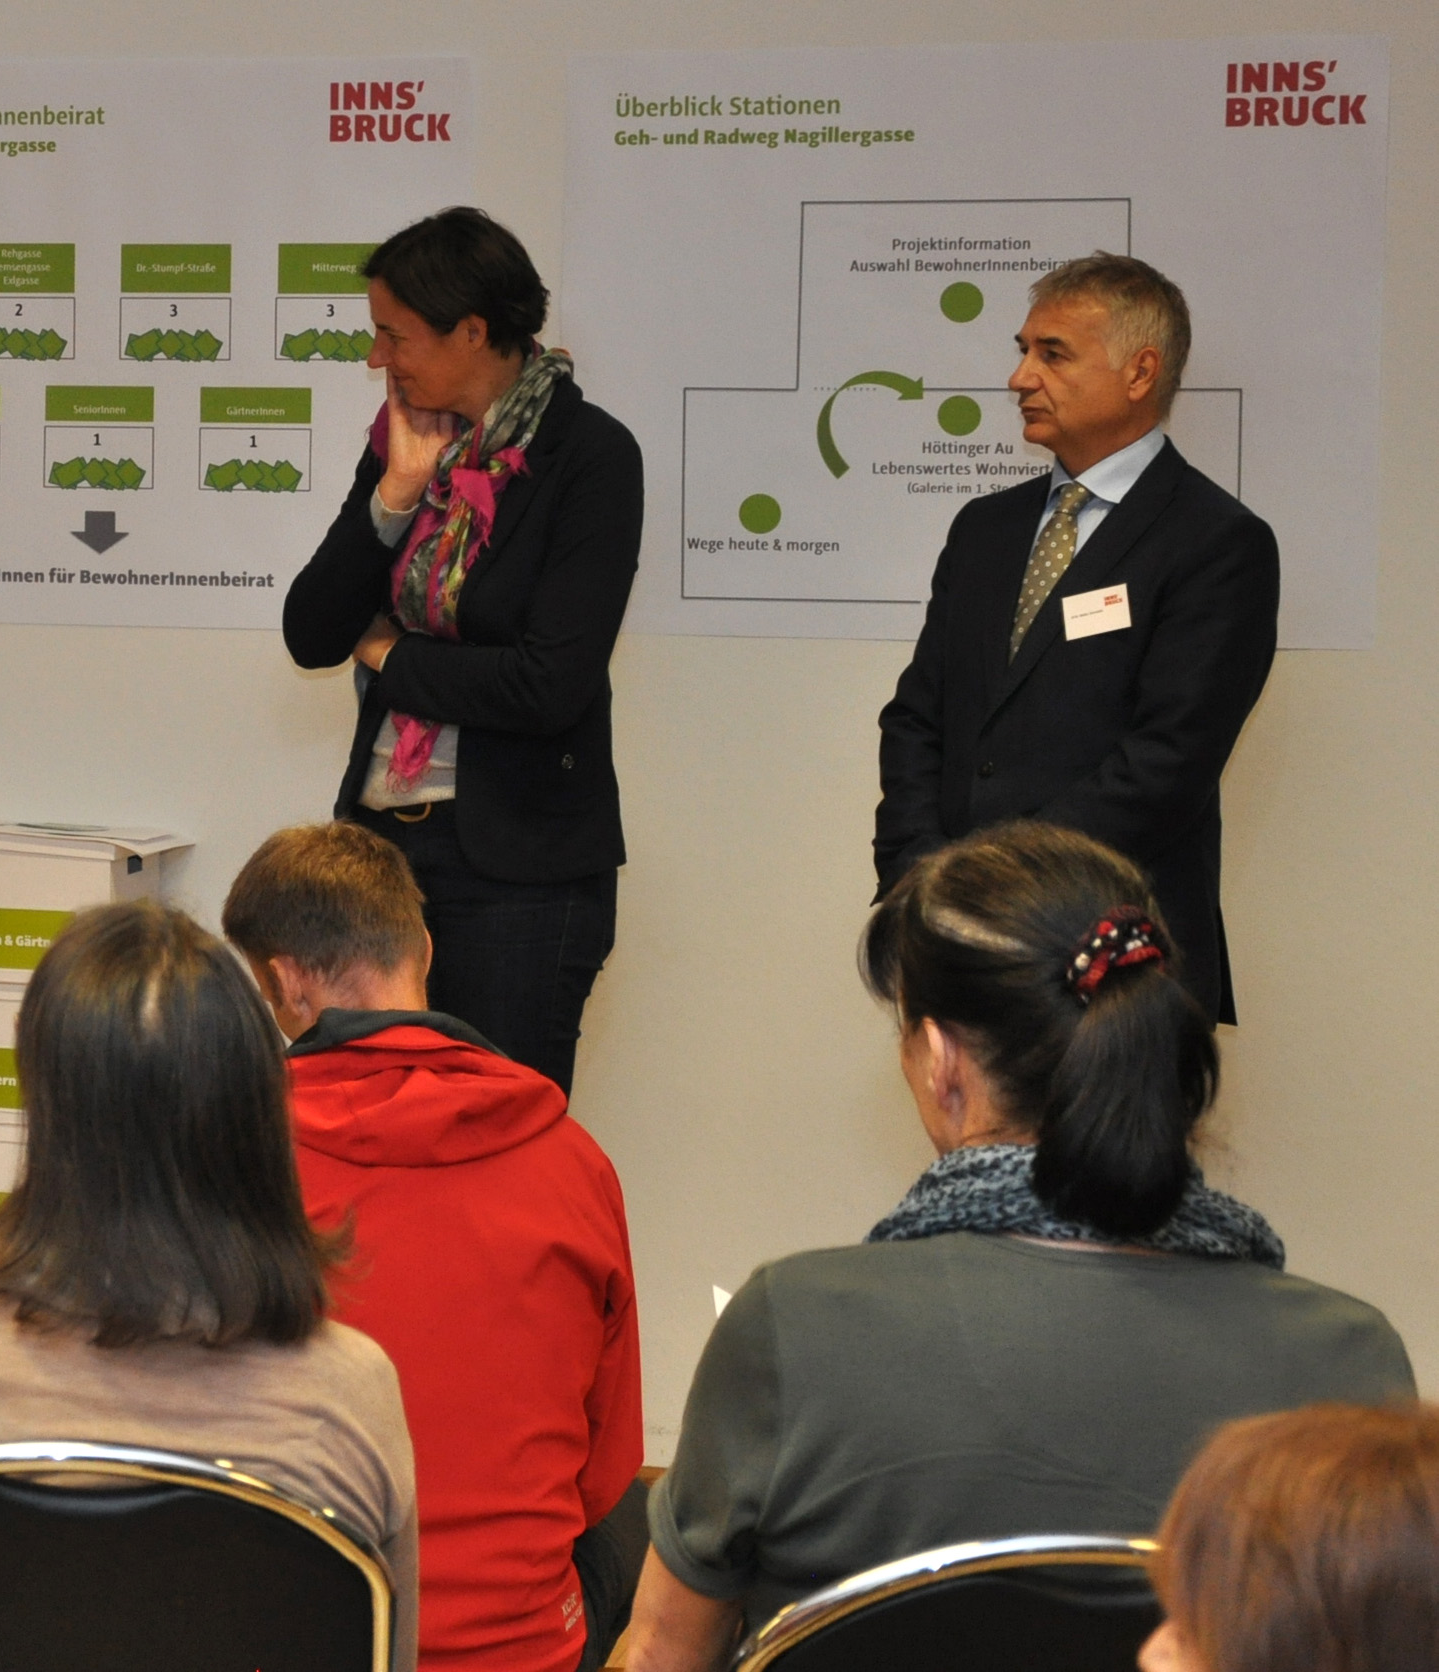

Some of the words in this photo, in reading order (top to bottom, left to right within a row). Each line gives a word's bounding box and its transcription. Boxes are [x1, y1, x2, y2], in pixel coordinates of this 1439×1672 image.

[615, 92, 723, 118] Überblick
[729, 94, 841, 116] Stationen
[1225, 95, 1367, 127] BRUCK
[329, 113, 450, 142] BRUCK
[614, 129, 658, 146] Geh-
[663, 128, 699, 145] und
[704, 127, 779, 148] Radweg
[784, 126, 915, 148] Nagillergasse
[892, 237, 1031, 254] Projektinformation
[1, 249, 42, 260] Rehgasse
[136, 263, 216, 275] Dr.-Stumpf-Straße
[312, 263, 357, 275] Mitterweg
[850, 258, 910, 272] Auswahl
[915, 257, 1070, 272] BewohnerInnenbeira
[3, 275, 40, 287] Exlgasse
[15, 303, 23, 316] 2
[169, 304, 178, 317] 3
[326, 304, 335, 317] 3
[73, 404, 126, 415] SeniorInnen
[226, 405, 285, 416] GärtnerInnen
[93, 433, 102, 446] 1
[249, 434, 258, 448] 1
[922, 441, 990, 458] Höttinger
[994, 442, 1014, 455] Au
[872, 461, 971, 475] Lebenswertes
[975, 461, 1053, 476] Wohnviert
[907, 482, 953, 495] (Galerie
[956, 483, 972, 494] im
[976, 483, 986, 494] 1.
[687, 537, 724, 554] Wege
[728, 537, 769, 551] heute
[773, 538, 783, 551] &
[786, 540, 840, 556] morgen
[49, 567, 75, 584] für
[80, 569, 274, 587] BewohnerInnenbeirat
[4, 935, 13, 946] &
